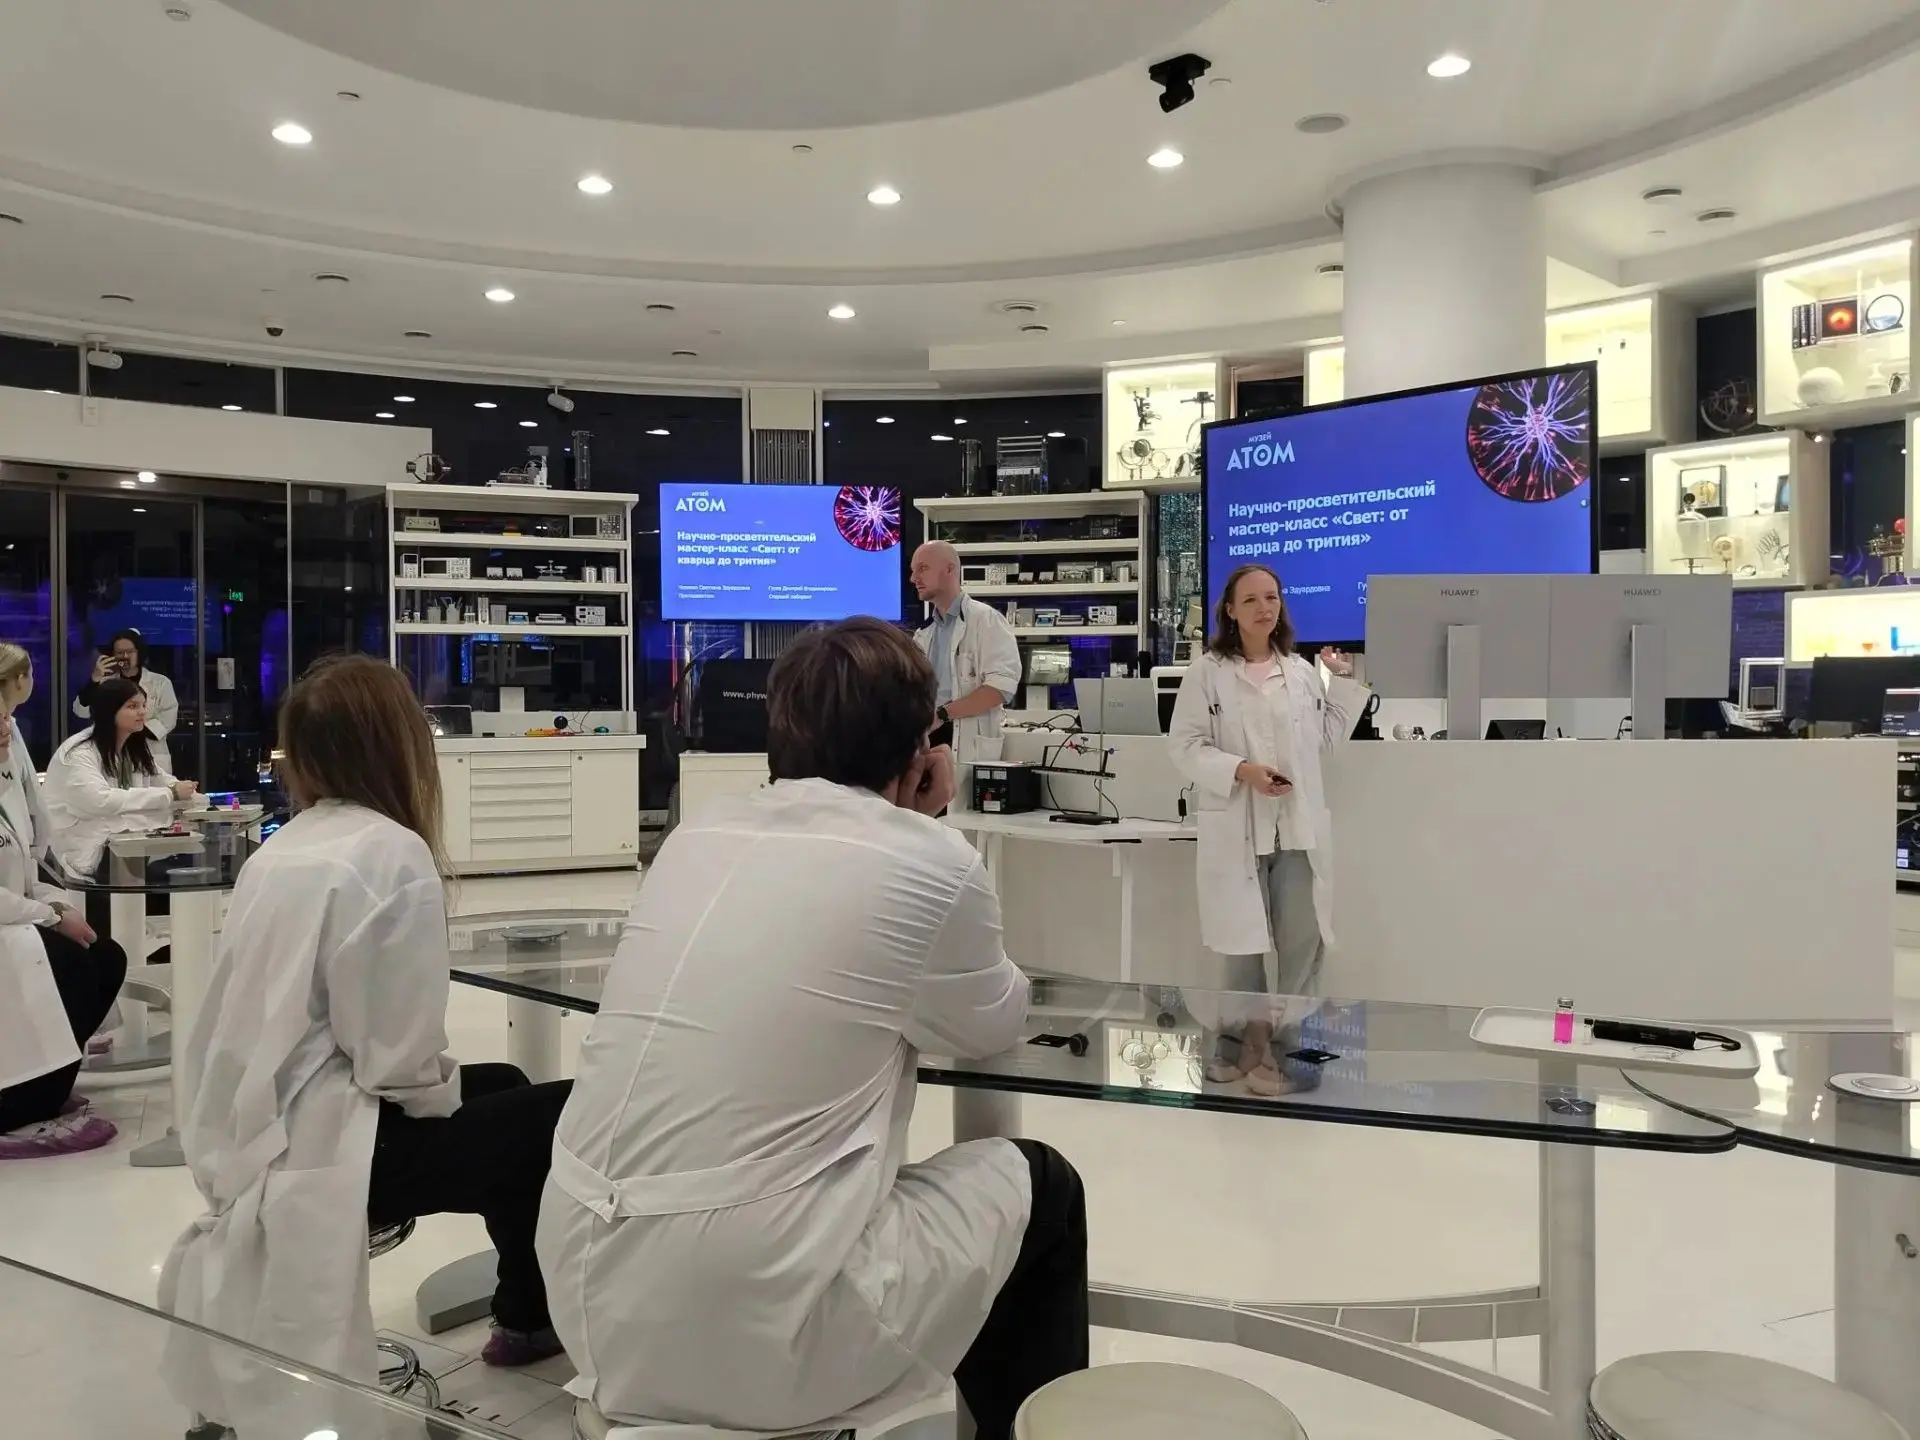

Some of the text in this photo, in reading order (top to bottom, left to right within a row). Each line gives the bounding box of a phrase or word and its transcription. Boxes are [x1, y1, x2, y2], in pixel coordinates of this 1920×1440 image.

[1248, 432, 1272, 443] МУЗЕЙ
[1226, 440, 1296, 471] АТОМ
[675, 497, 726, 512] АТОМ
[1229, 480, 1436, 518] Научно-просветительский
[1229, 508, 1409, 537] мастер-класс «Свет: от
[677, 531, 816, 543] Научно-просветительский
[677, 544, 801, 555] мастер-класс «Свет: от
[1229, 533, 1372, 556] кварца до трития»
[677, 556, 777, 567] кварца до трития»
[1440, 589, 1480, 597] HUAWEI
[1623, 589, 1662, 597] HUAWEI
